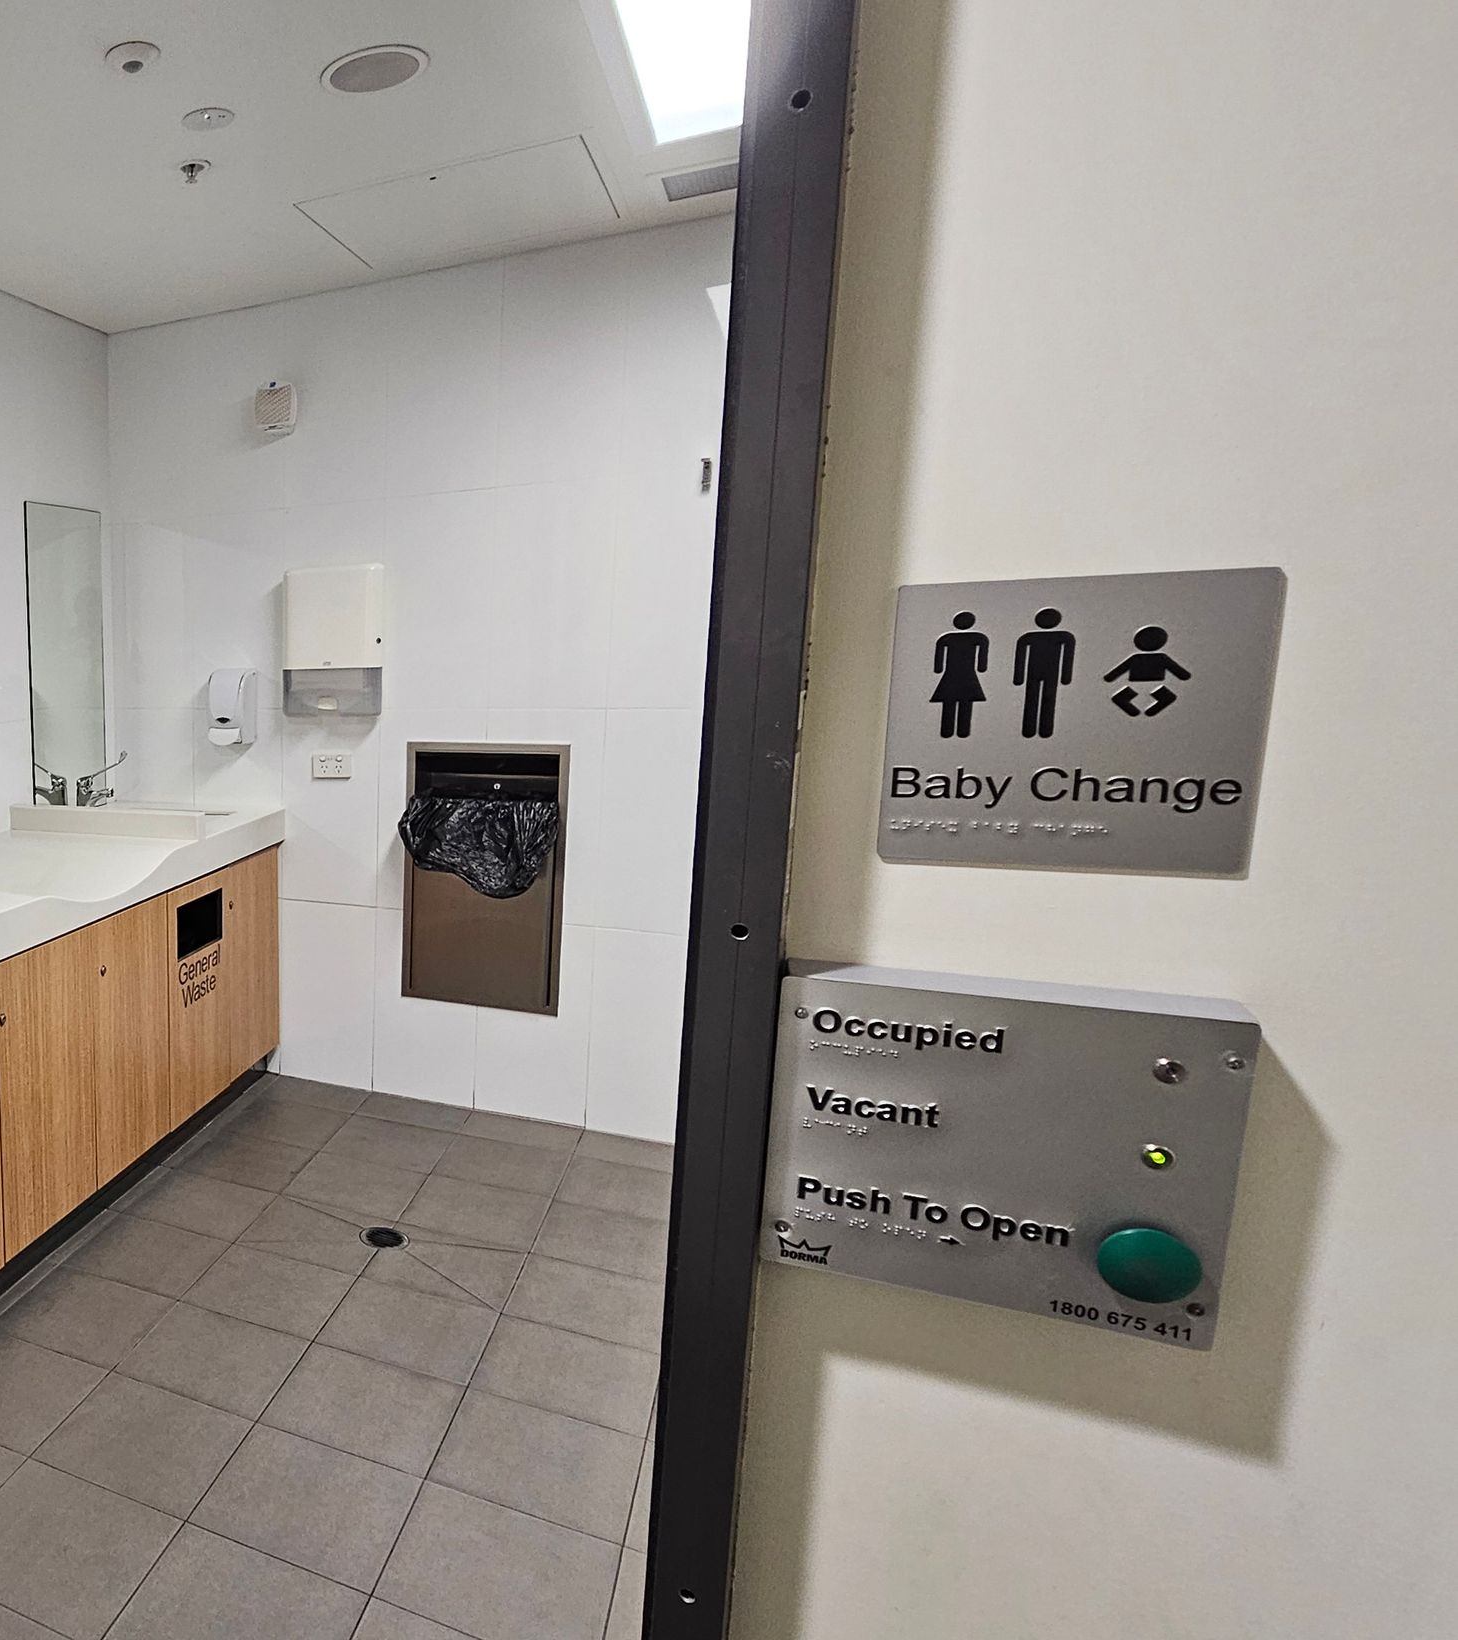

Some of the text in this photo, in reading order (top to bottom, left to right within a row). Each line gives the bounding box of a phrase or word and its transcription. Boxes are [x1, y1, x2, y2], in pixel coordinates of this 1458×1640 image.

[890, 766, 1243, 813] Baby Change
[178, 943, 221, 985] General
[181, 974, 217, 1008] Waste
[812, 1008, 1006, 1054] Occupied
[805, 1085, 941, 1128] Vacant
[796, 1176, 1072, 1247] Push To Open
[780, 1249, 828, 1265] DORMA
[1048, 1299, 1192, 1342] 1800 675 411
